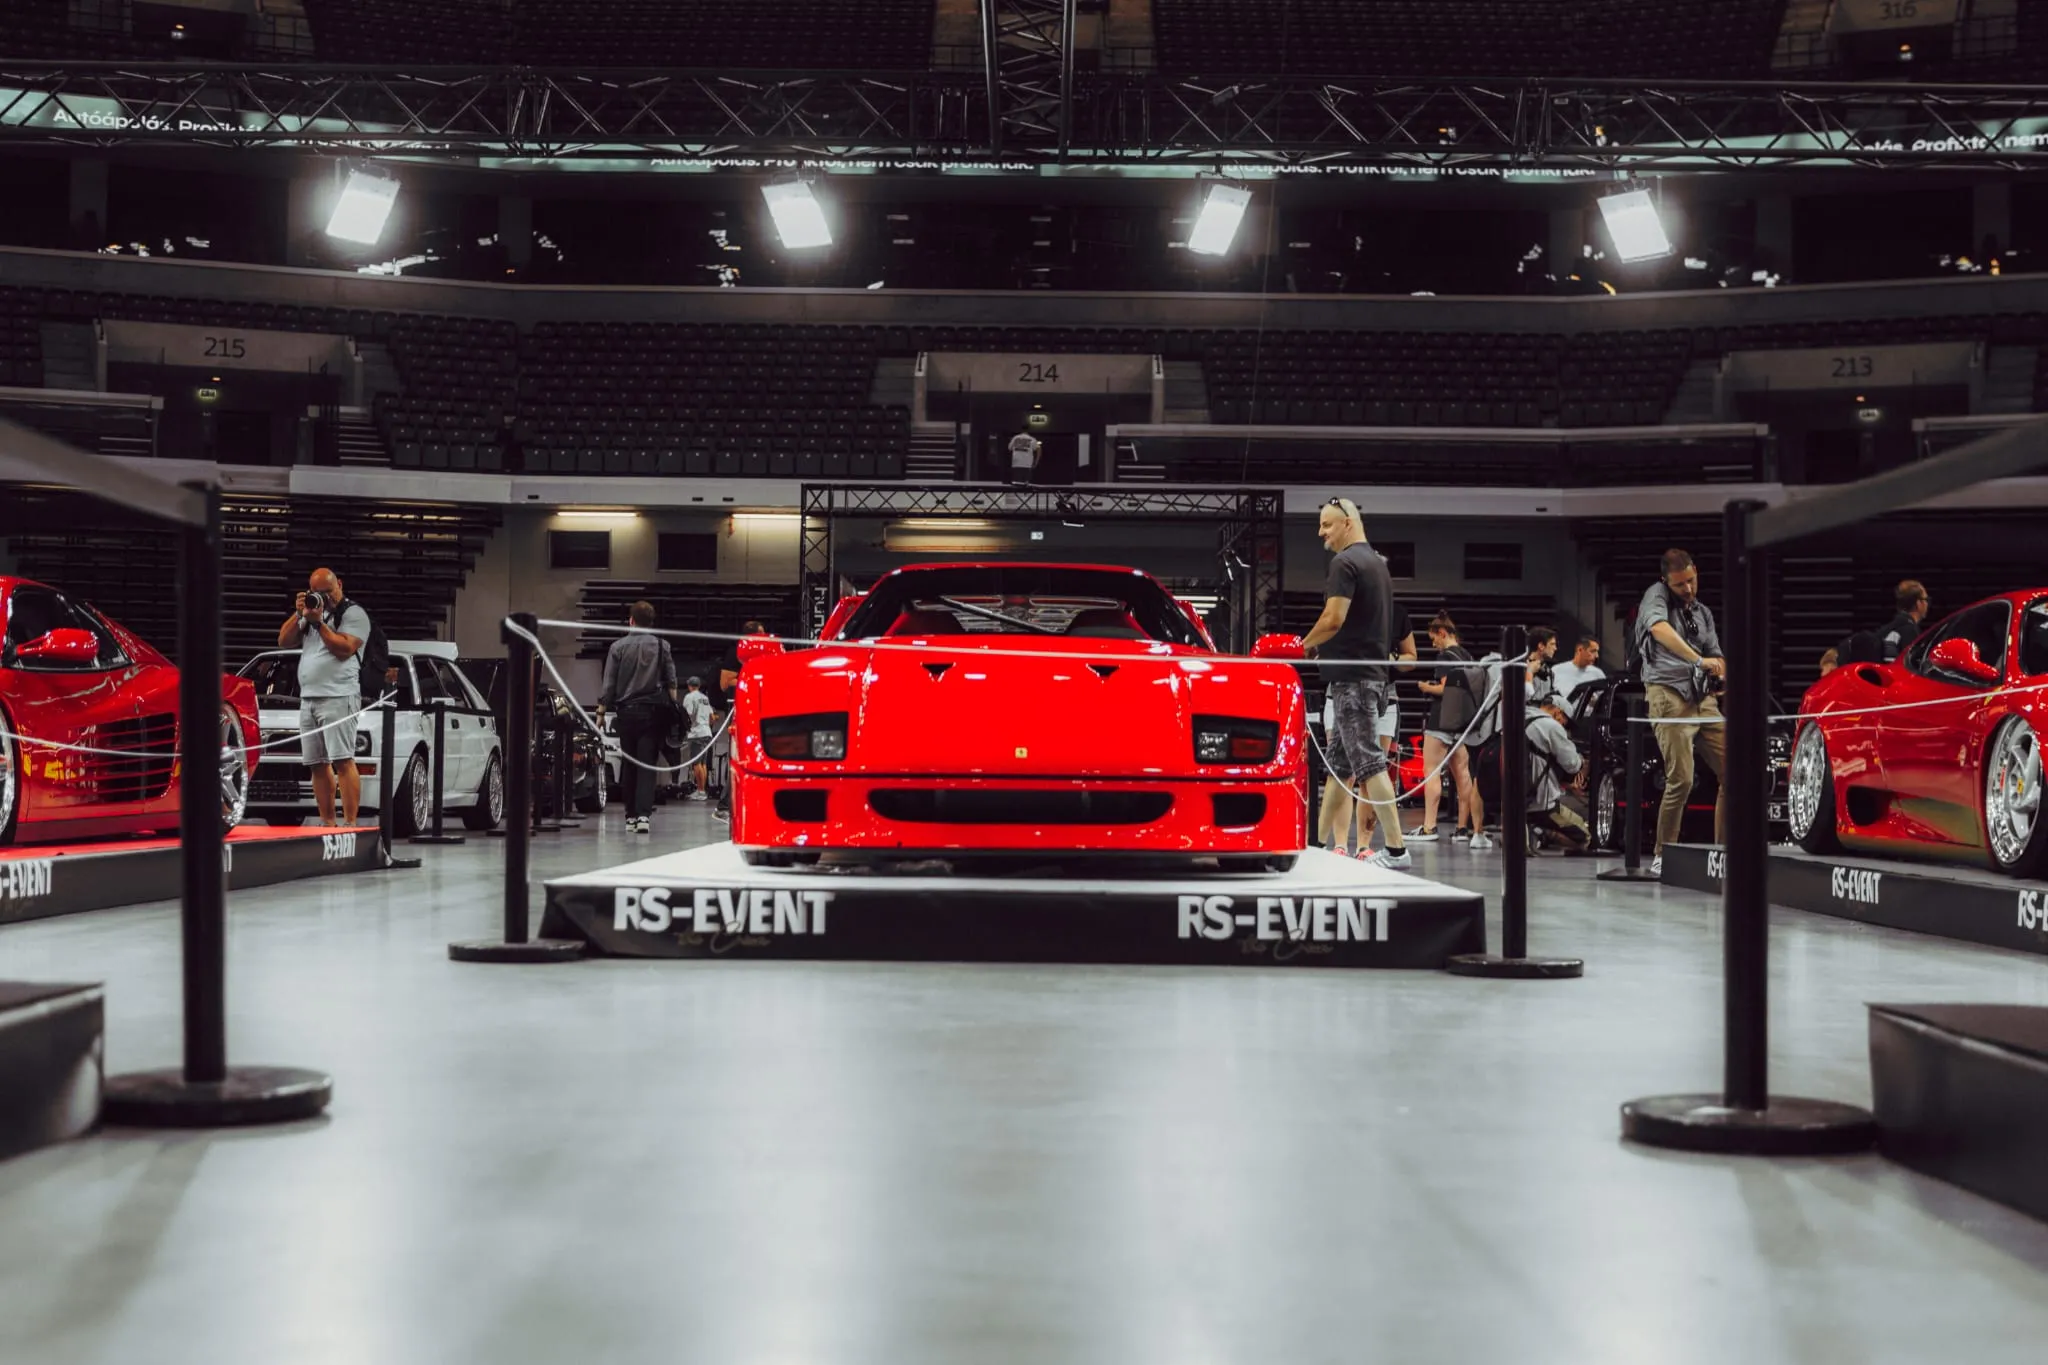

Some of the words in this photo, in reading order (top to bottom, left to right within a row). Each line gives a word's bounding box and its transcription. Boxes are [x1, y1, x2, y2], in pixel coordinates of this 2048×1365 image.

[1880, 0, 1917, 20] 316
[204, 336, 246, 359] 215
[1019, 363, 1058, 383] 214
[1832, 356, 1873, 377] 213
[1832, 866, 1882, 905] RS-EVENT
[613, 886, 835, 935] RS-EVENT
[1178, 895, 1398, 942] RS-EVENT
